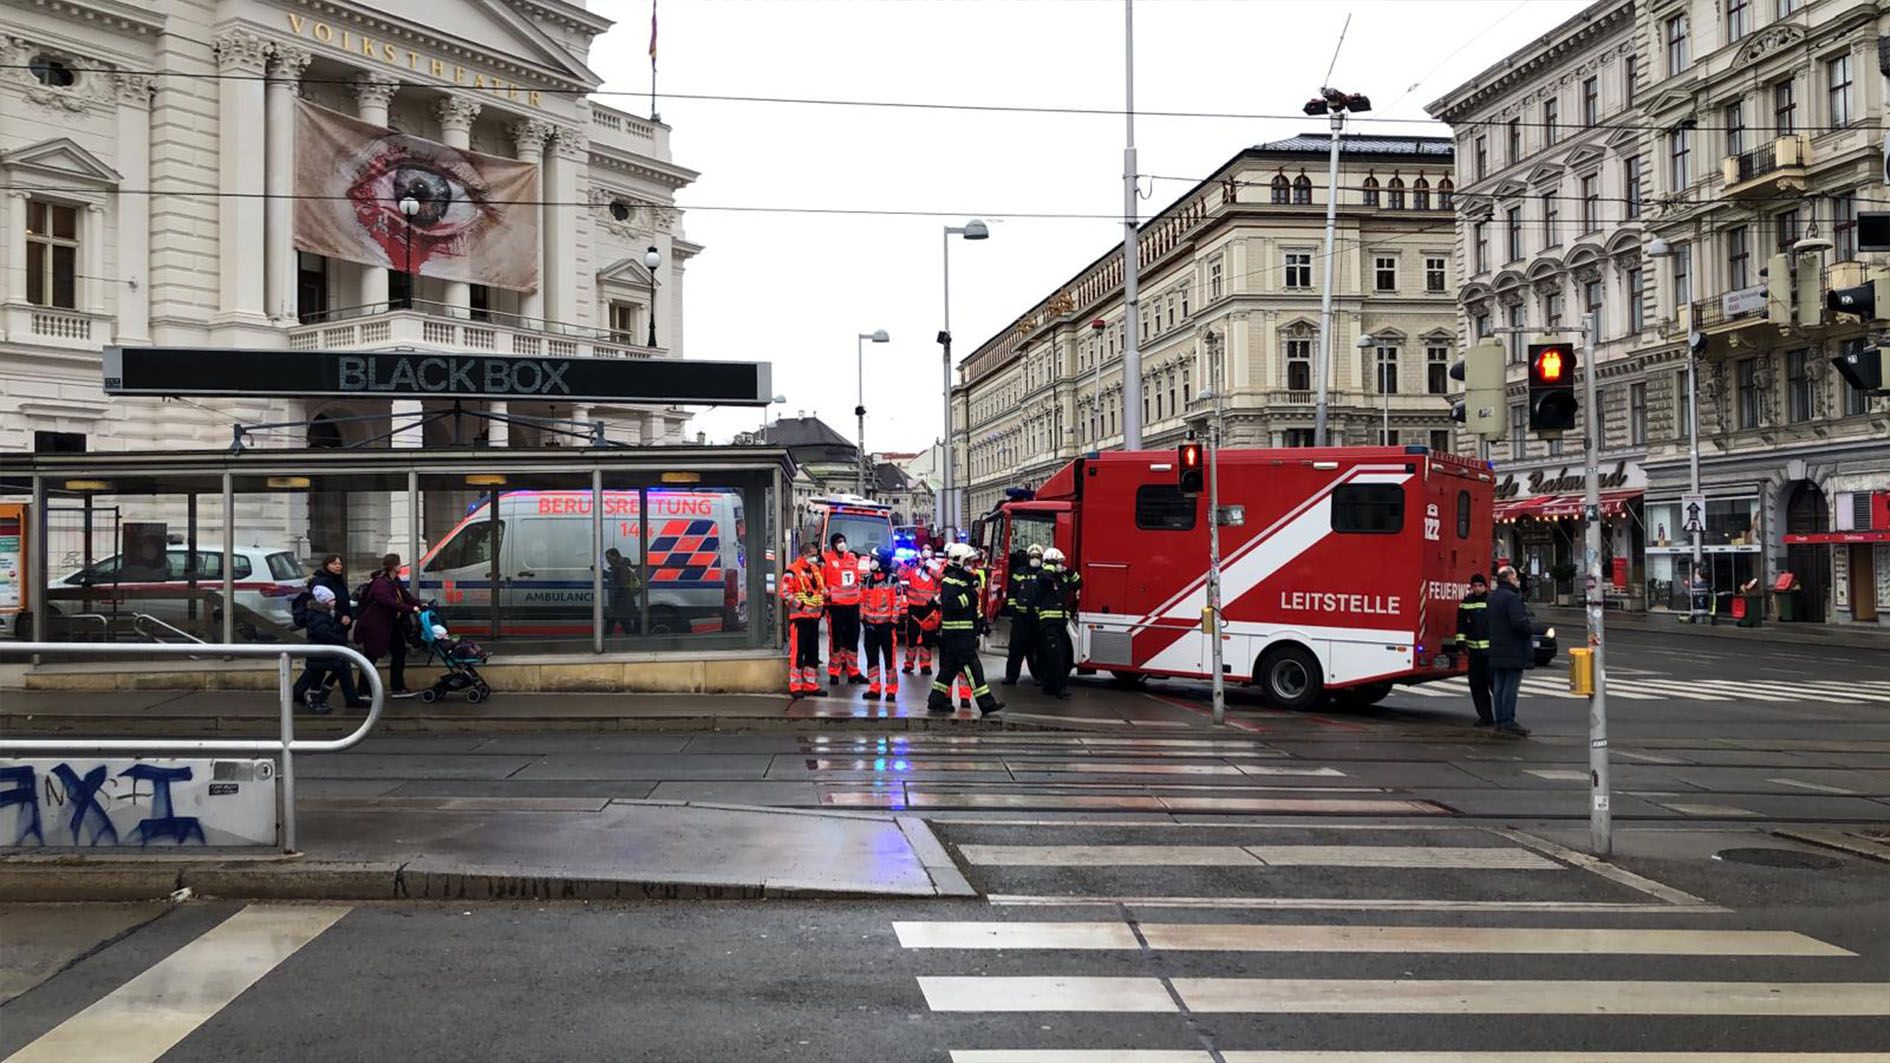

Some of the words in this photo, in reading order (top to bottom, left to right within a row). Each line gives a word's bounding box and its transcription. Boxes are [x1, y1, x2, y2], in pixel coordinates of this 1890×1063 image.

[288, 12, 542, 107] VOLKSTHEATER
[339, 356, 476, 391] BLACK
[484, 359, 570, 394] BOX
[538, 498, 712, 515] BERUSRETUNG
[1424, 517, 1440, 541] 122
[525, 592, 593, 602] AMBULANC
[1429, 581, 1473, 600] FEUERWE
[1280, 591, 1401, 615] LEITSTELLE
